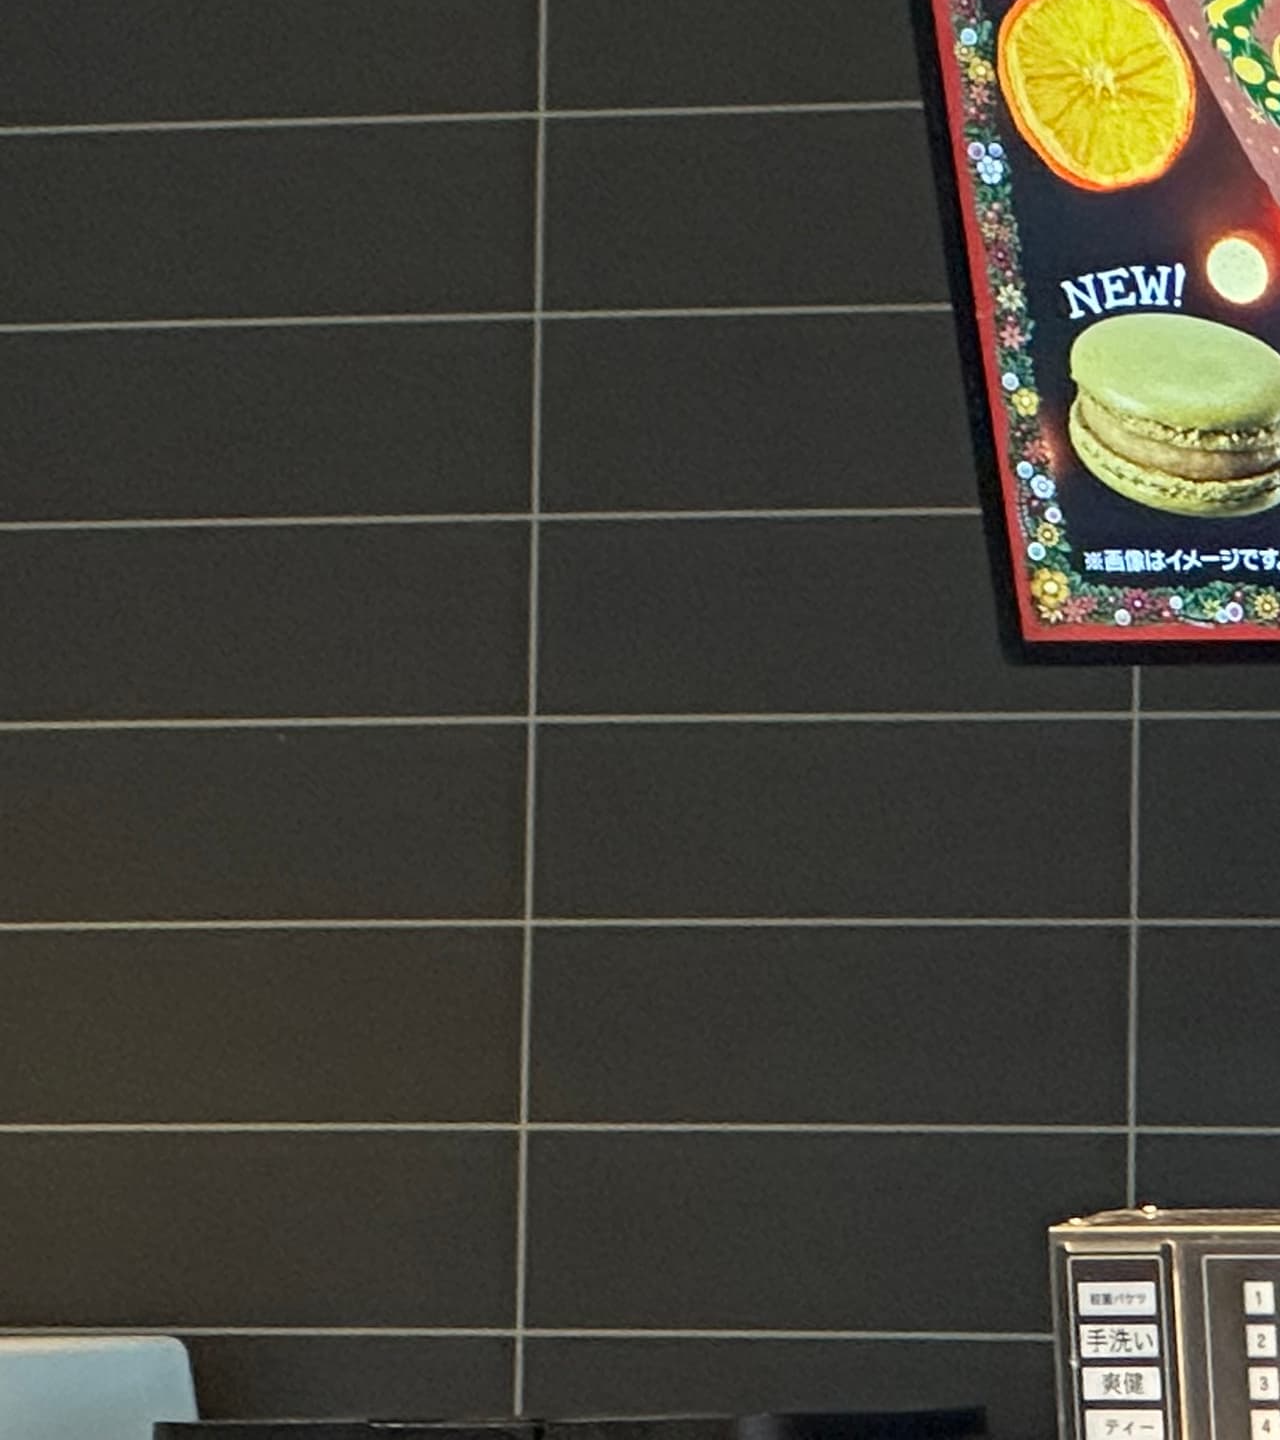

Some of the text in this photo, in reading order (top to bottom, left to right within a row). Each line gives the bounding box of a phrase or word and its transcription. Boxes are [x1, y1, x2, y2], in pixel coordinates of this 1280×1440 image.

[1061, 263, 1186, 319] NEW!
[1086, 1328, 1153, 1353] 手洗い
[1257, 1334, 1266, 1348] 2
[1259, 1376, 1269, 1391] 3
[1262, 1419, 1271, 1433] 4
